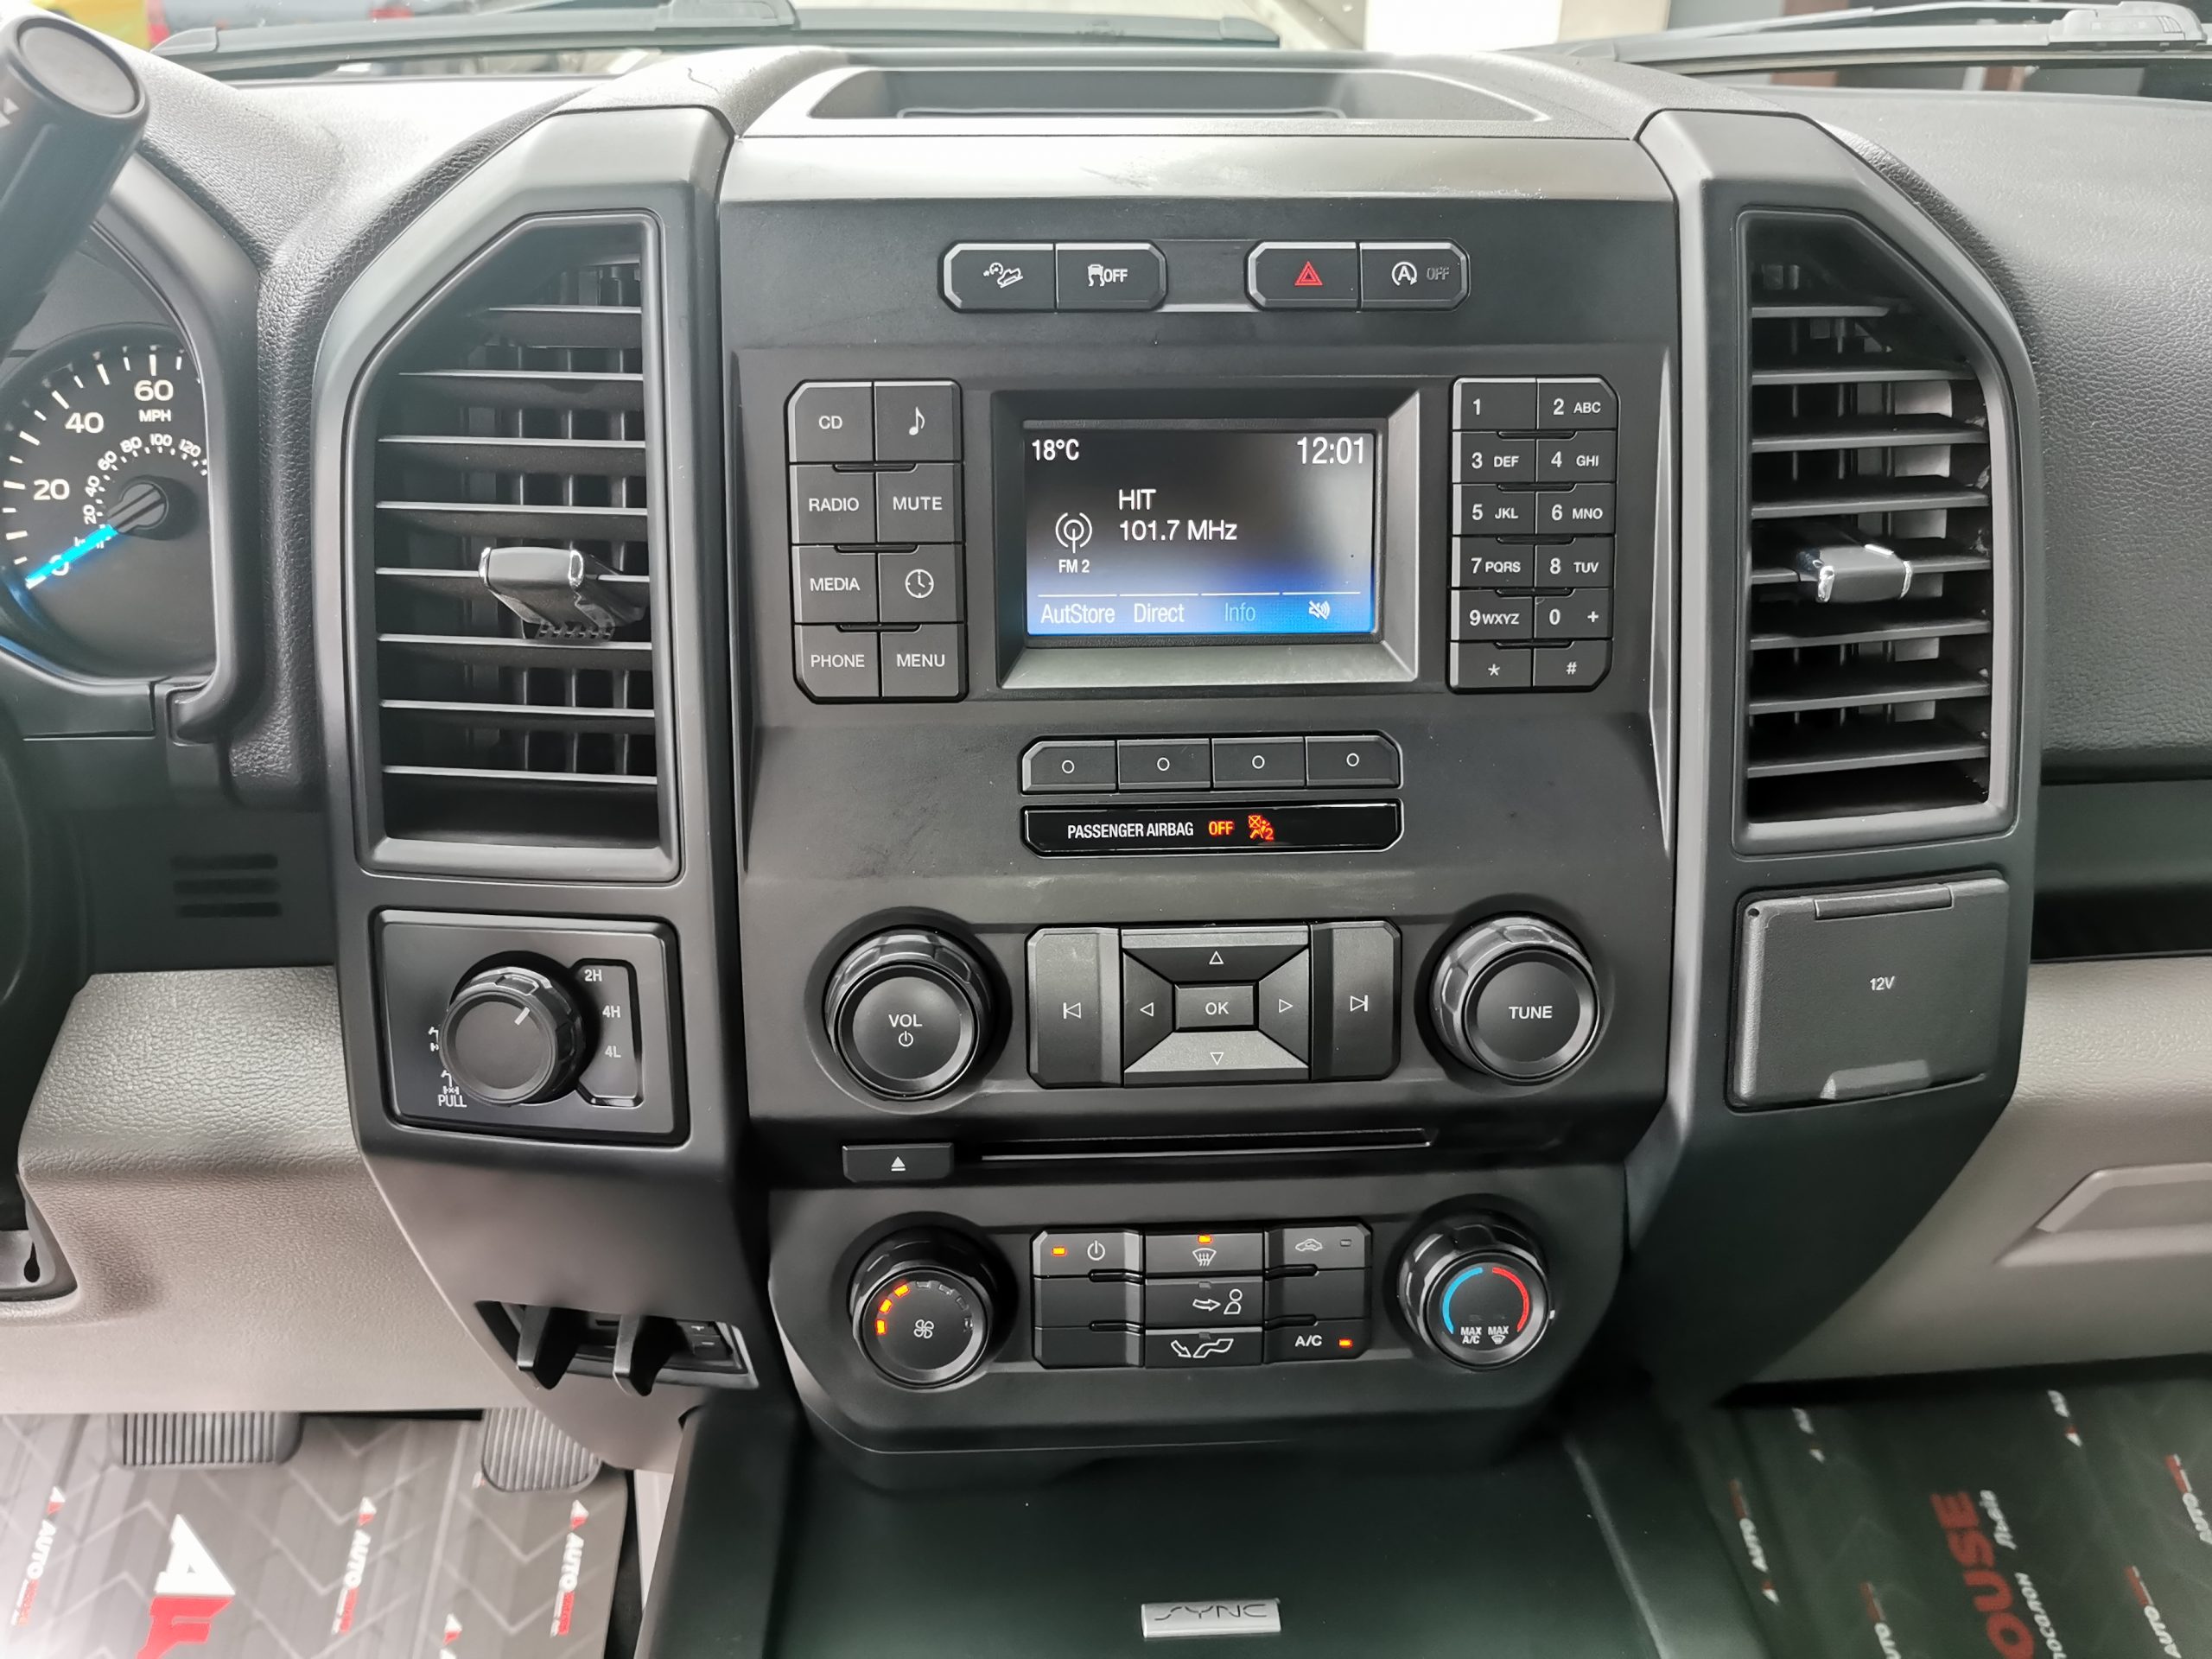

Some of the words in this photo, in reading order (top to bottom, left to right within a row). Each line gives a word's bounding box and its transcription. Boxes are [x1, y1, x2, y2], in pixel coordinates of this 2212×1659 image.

[1104, 268, 1128, 283] OFF
[1426, 266, 1450, 281] OFF
[134, 379, 174, 402] 60
[1472, 398, 1481, 416] 1
[1553, 397, 1565, 416] 2
[1573, 401, 1601, 414] ABC
[64, 411, 105, 434] 40
[138, 409, 172, 423] MPH
[818, 415, 843, 429] CD
[119, 436, 143, 453] 80
[149, 433, 173, 447] 100
[178, 438, 202, 458] 120
[1032, 438, 1079, 461] 18°C
[1296, 435, 1364, 465] 12:01
[97, 451, 118, 470] 60
[1471, 451, 1483, 469] 3
[1493, 455, 1520, 467] DEF
[1550, 450, 1563, 468] 4
[1576, 454, 1599, 467] GHI
[33, 478, 70, 501] 20
[85, 476, 100, 498] 40
[808, 497, 860, 512] RADIO
[893, 496, 943, 511] MUTE
[1118, 488, 1157, 511] HIT
[83, 504, 98, 524] 20
[1471, 503, 1484, 521] 5
[1494, 507, 1519, 519] JKL
[1551, 504, 1563, 521] 6
[1572, 507, 1604, 520] MNO
[1119, 519, 1180, 541] 101.7
[1187, 519, 1237, 541] MHz
[1058, 558, 1078, 574] FM
[1081, 558, 1090, 574] 2
[1471, 556, 1483, 574] 7
[1484, 561, 1522, 574] PQRS
[1549, 557, 1561, 575] 8
[1573, 562, 1599, 574] TUV
[810, 577, 861, 592] MEDIA
[1039, 603, 1116, 624] AutStore
[1134, 602, 1185, 623] Direct
[1224, 602, 1256, 624] Info
[1469, 609, 1482, 626] 9
[1482, 613, 1520, 625] WXYZ
[1548, 608, 1560, 626] 0
[810, 653, 865, 668] PHONE
[896, 653, 945, 668] MENU
[1067, 823, 1144, 839] PASSENGER
[1146, 821, 1194, 837] AIRBAG
[1208, 820, 1234, 836] OFF
[584, 968, 603, 982] 2H
[1869, 976, 1896, 991] 12V
[602, 1005, 621, 1019] 4H
[1205, 1001, 1230, 1015] OK
[1508, 1005, 1553, 1020] TUNE
[888, 1014, 923, 1028] VOL
[604, 1045, 622, 1058] 4L
[437, 1094, 468, 1108] PULL
[1460, 1326, 1482, 1336] MAX
[1487, 1325, 1510, 1335] MAX
[1294, 1334, 1323, 1347] A/C
[1461, 1336, 1481, 1344] A/C
[27, 1519, 56, 1580] AUTO
[343, 1529, 372, 1589] AUTO
[559, 1532, 585, 1592] AUTO
[1154, 1603, 1268, 1621] SYNC
